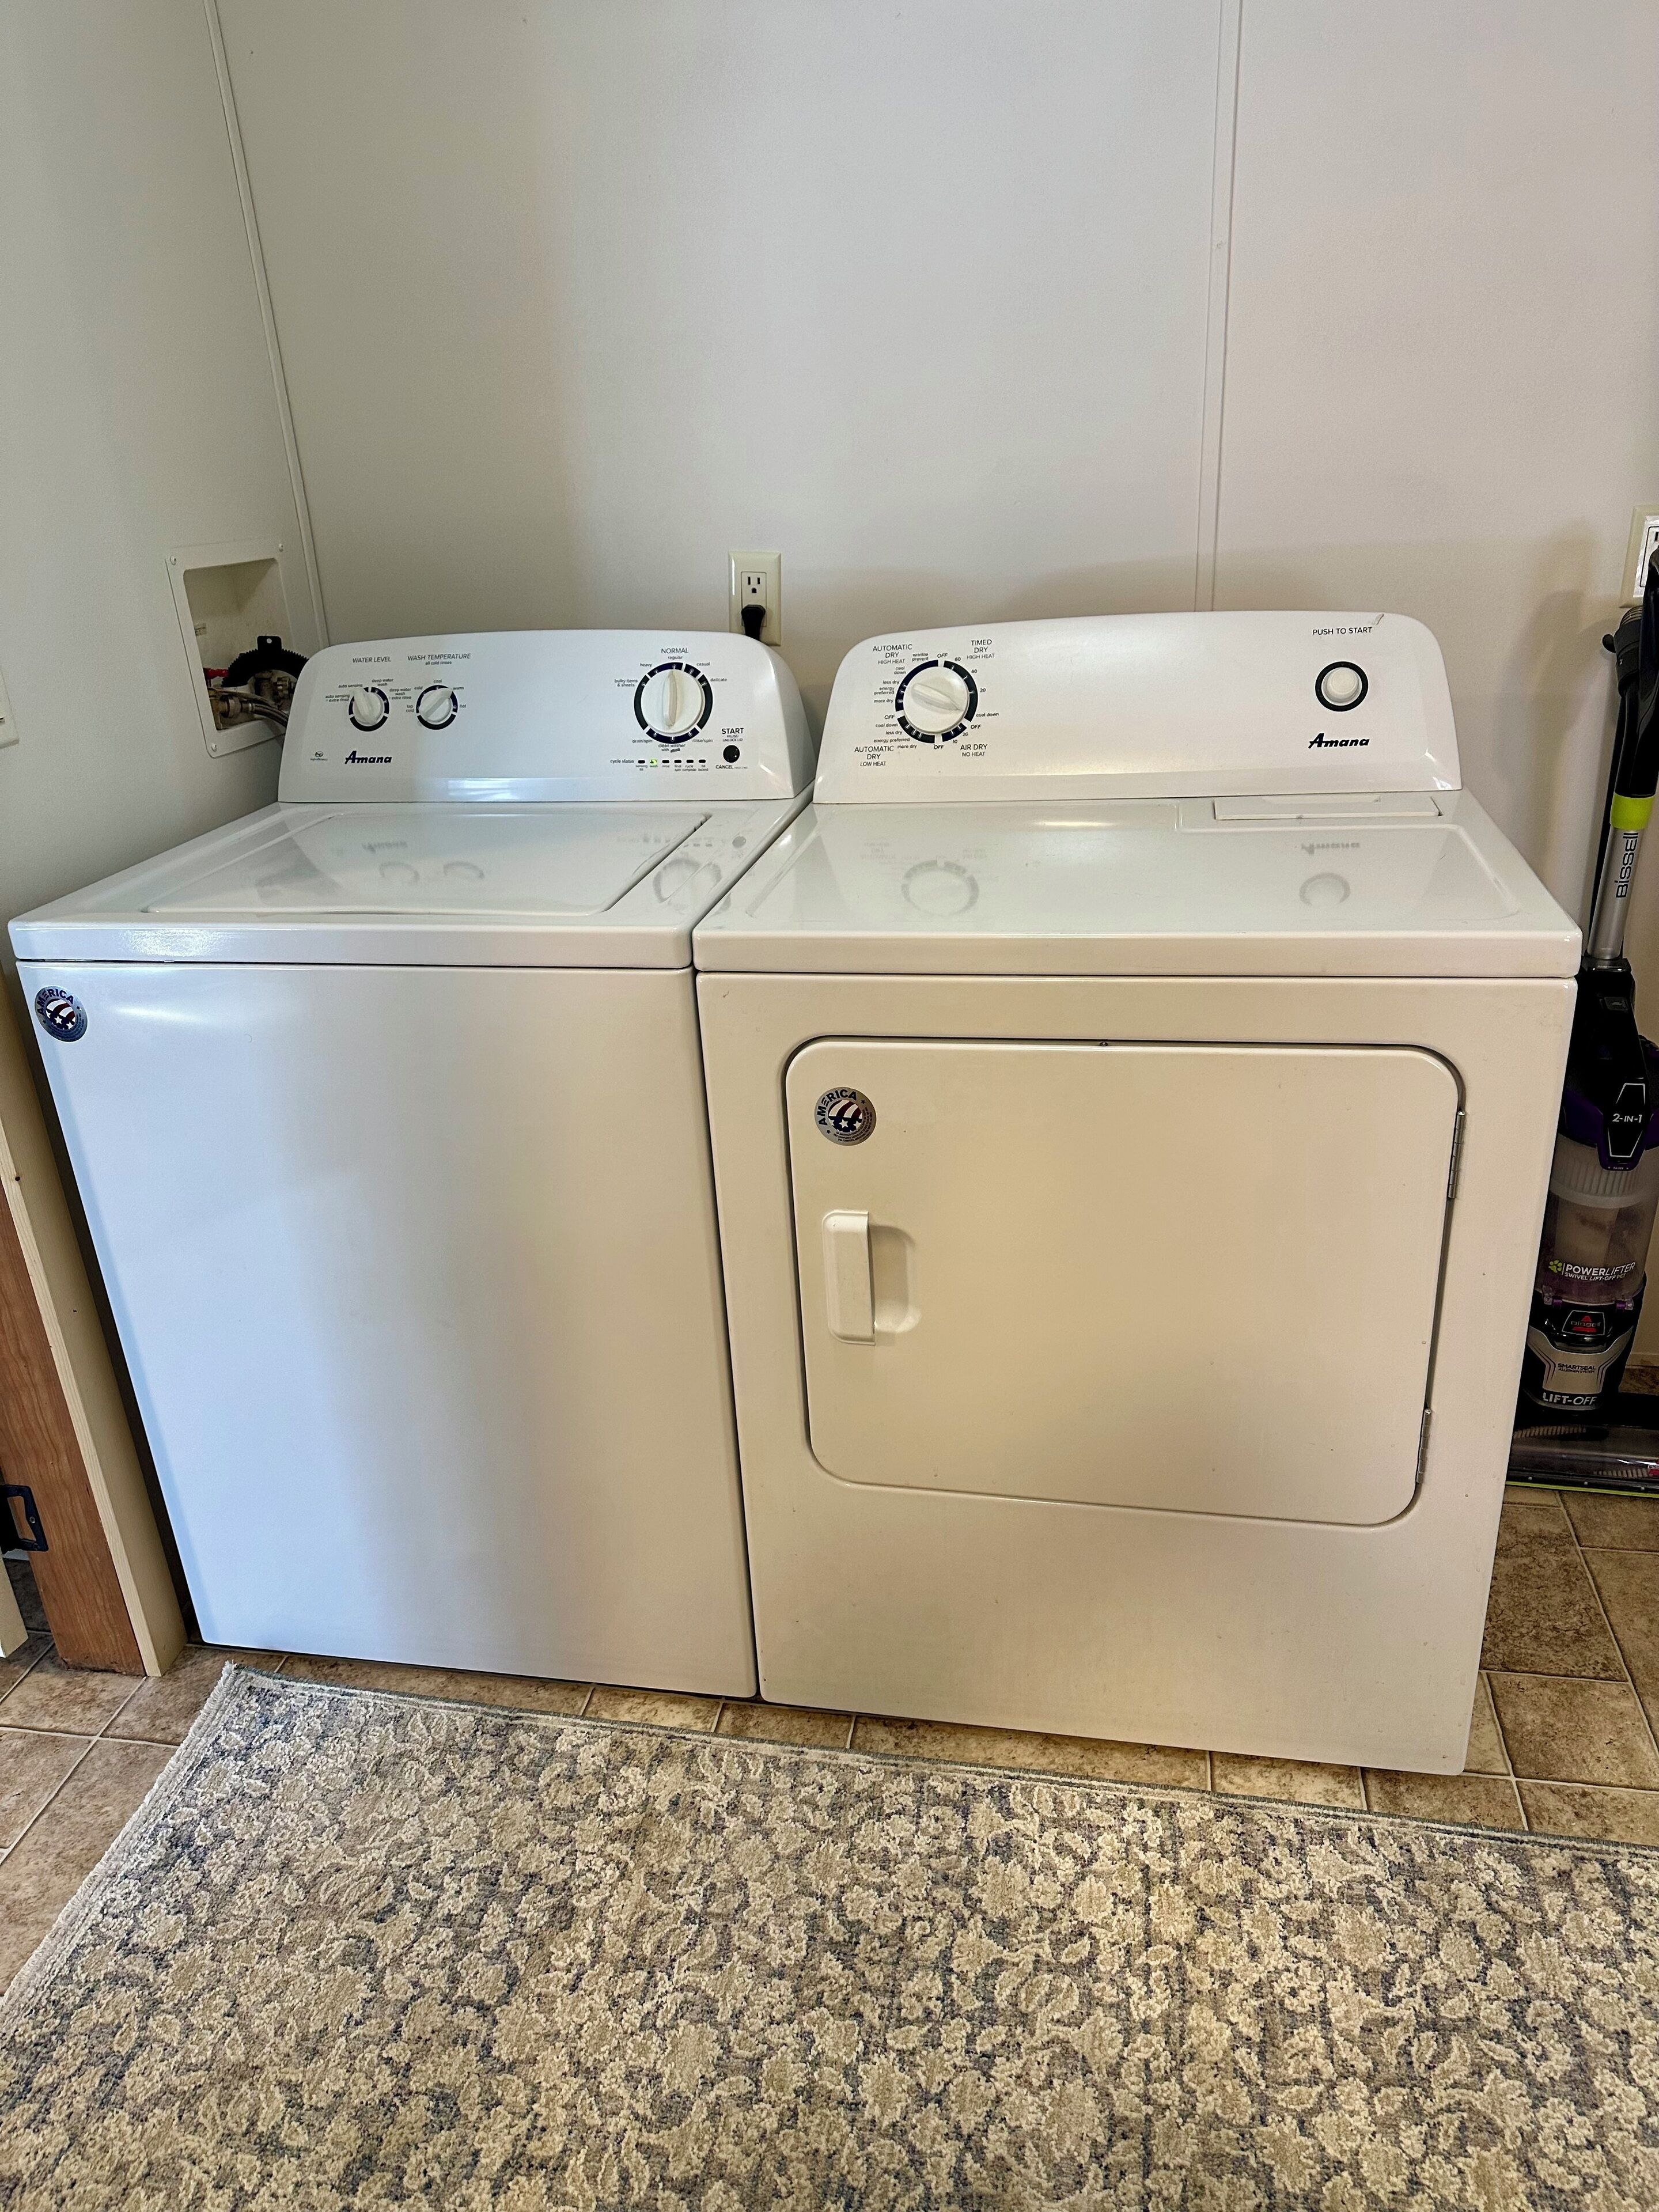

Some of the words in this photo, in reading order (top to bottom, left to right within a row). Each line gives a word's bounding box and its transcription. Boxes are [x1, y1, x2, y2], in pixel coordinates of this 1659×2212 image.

[1308, 733, 1370, 749] Amana
[344, 751, 392, 764] Amana
[37, 988, 74, 1017] AMERICA
[817, 1089, 857, 1126] AMERICA
[1612, 1113, 1643, 1123] 2-IN-1
[1566, 1262, 1635, 1276] POWERLIFTER
[1565, 1272, 1588, 1281] SWIVEL
[1543, 1392, 1597, 1405] LIFT-OFF
